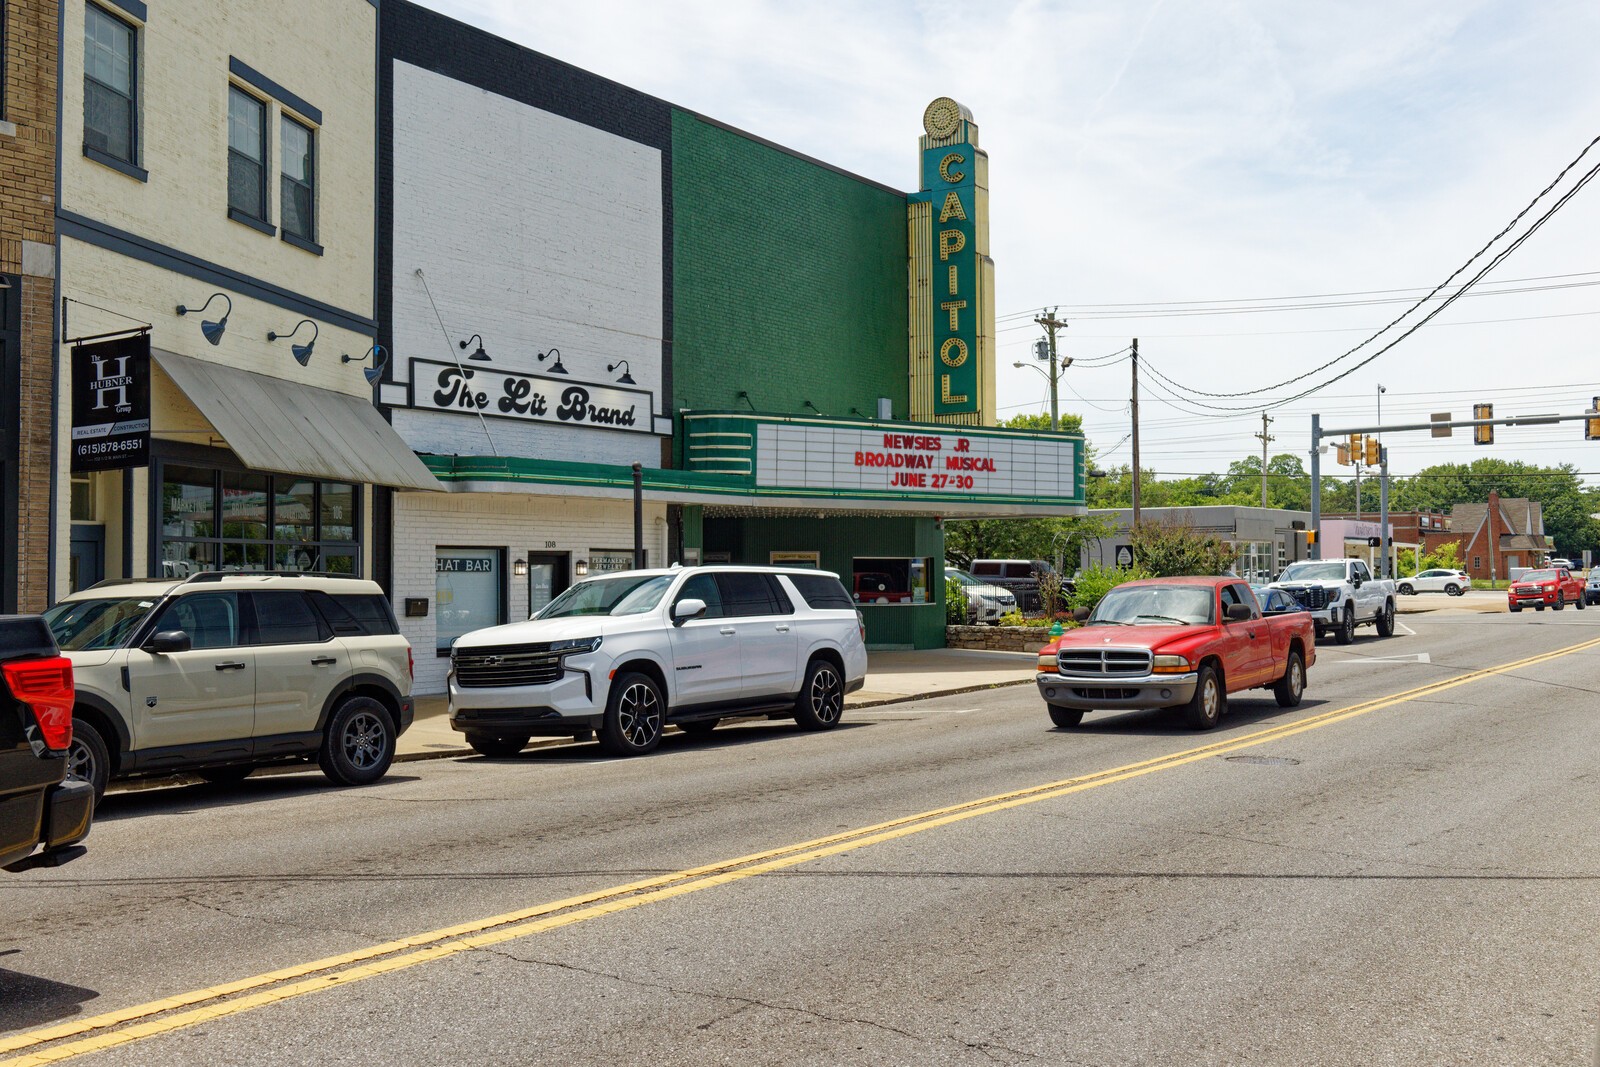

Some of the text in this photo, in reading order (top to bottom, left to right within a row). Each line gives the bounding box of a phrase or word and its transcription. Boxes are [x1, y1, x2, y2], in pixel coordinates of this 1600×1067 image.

[938, 152, 969, 404] CAPITOL
[91, 354, 101, 362] The
[90, 376, 133, 390] HUBNER
[433, 367, 636, 427] The Lit Brand
[115, 405, 132, 414] Group
[113, 422, 149, 432] CONSTRUCTION
[77, 439, 143, 456] (615)878-6551
[883, 433, 970, 452] NEWSIES JR
[854, 451, 997, 472] BROADWAY MUSICAL
[890, 472, 927, 488] JUNE
[170, 497, 207, 513] MARKETING
[332, 505, 343, 520] 106
[545, 541, 556, 549] 108
[435, 559, 491, 572] HAT BAR
